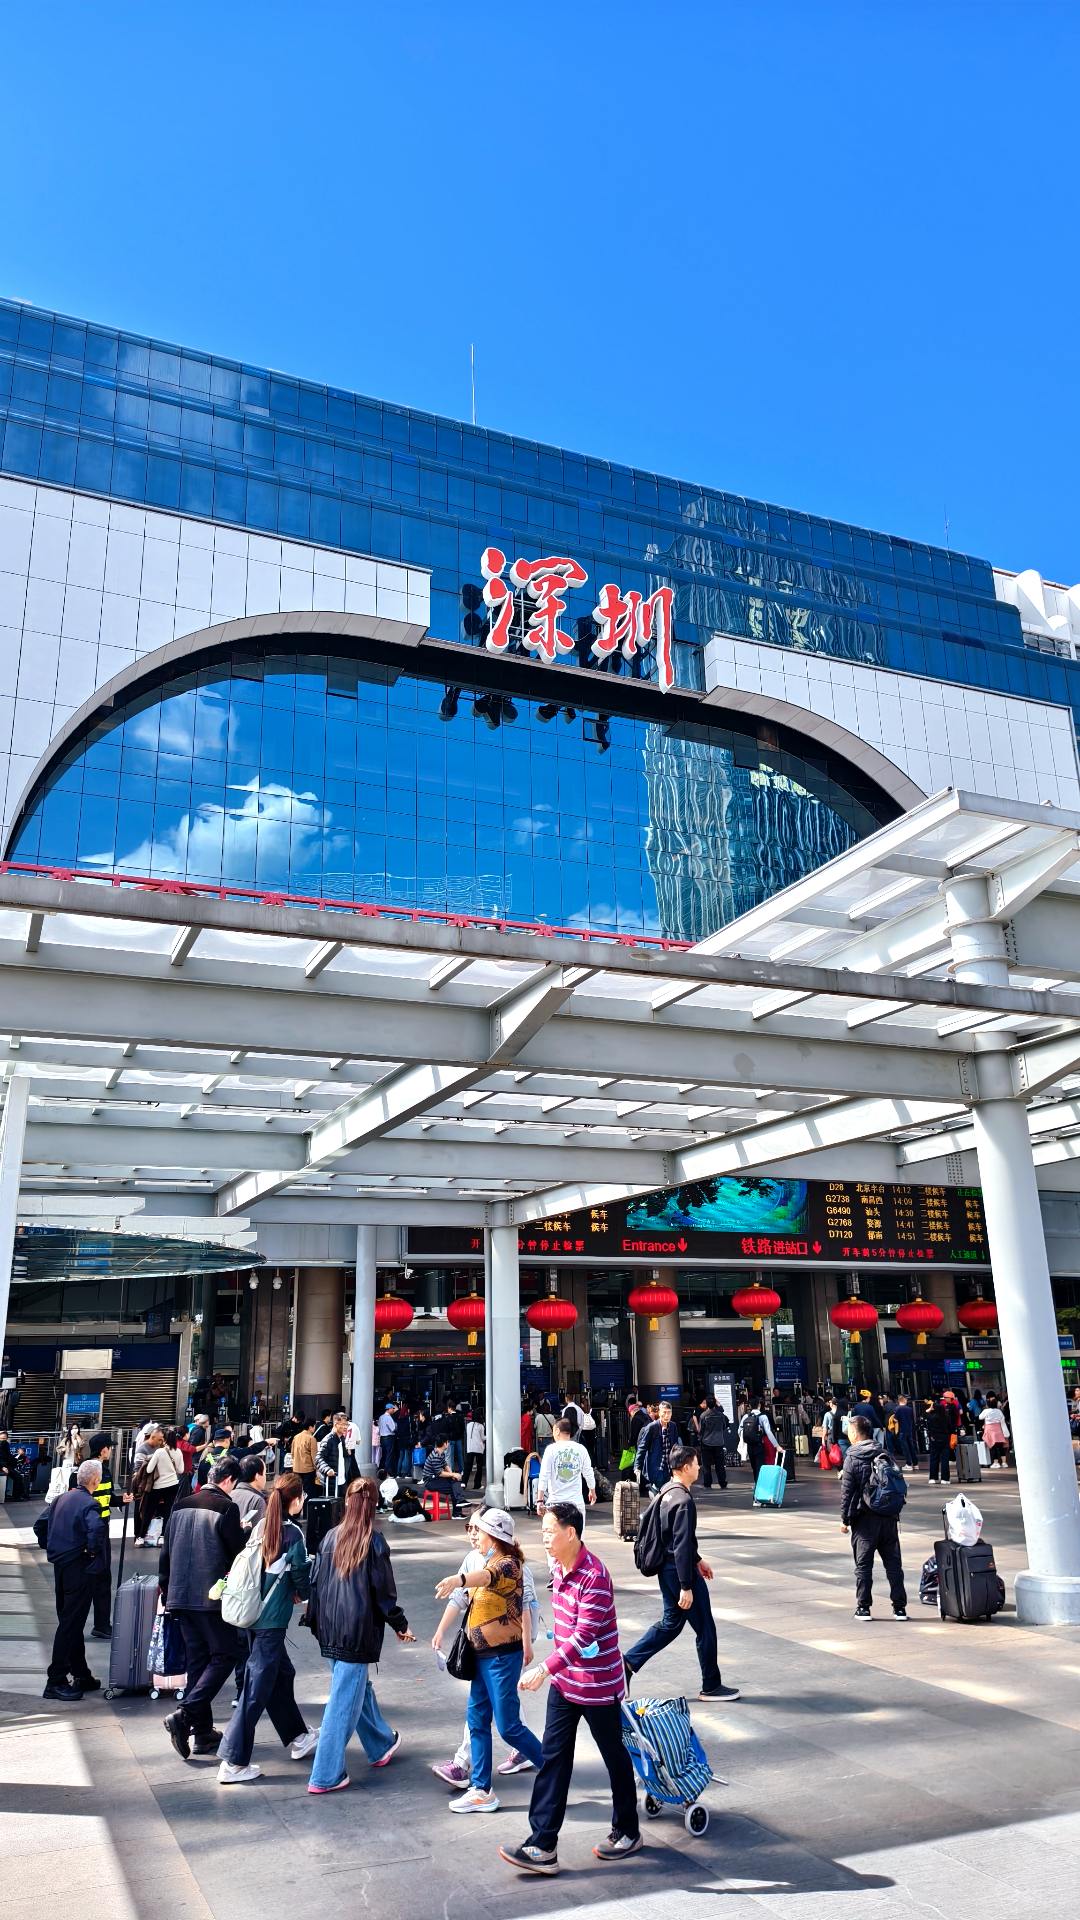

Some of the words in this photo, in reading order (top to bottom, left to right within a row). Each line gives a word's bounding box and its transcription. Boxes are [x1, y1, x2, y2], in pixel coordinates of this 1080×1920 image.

[480, 547, 675, 694] 深圳
[829, 1183, 844, 1191] D28
[855, 1183, 885, 1194] 北京丰台
[860, 1195, 884, 1205] 南昌西
[826, 1207, 851, 1215] G6490
[865, 1207, 881, 1217] 汕头
[895, 1209, 914, 1217] 14:30
[590, 1222, 609, 1233] 候车
[896, 1220, 914, 1229] 14:41
[829, 1230, 853, 1239] D7120
[897, 1232, 916, 1241] 14:51
[622, 1239, 676, 1253] Entrance
[741, 1237, 808, 1255] 铁路进站口
